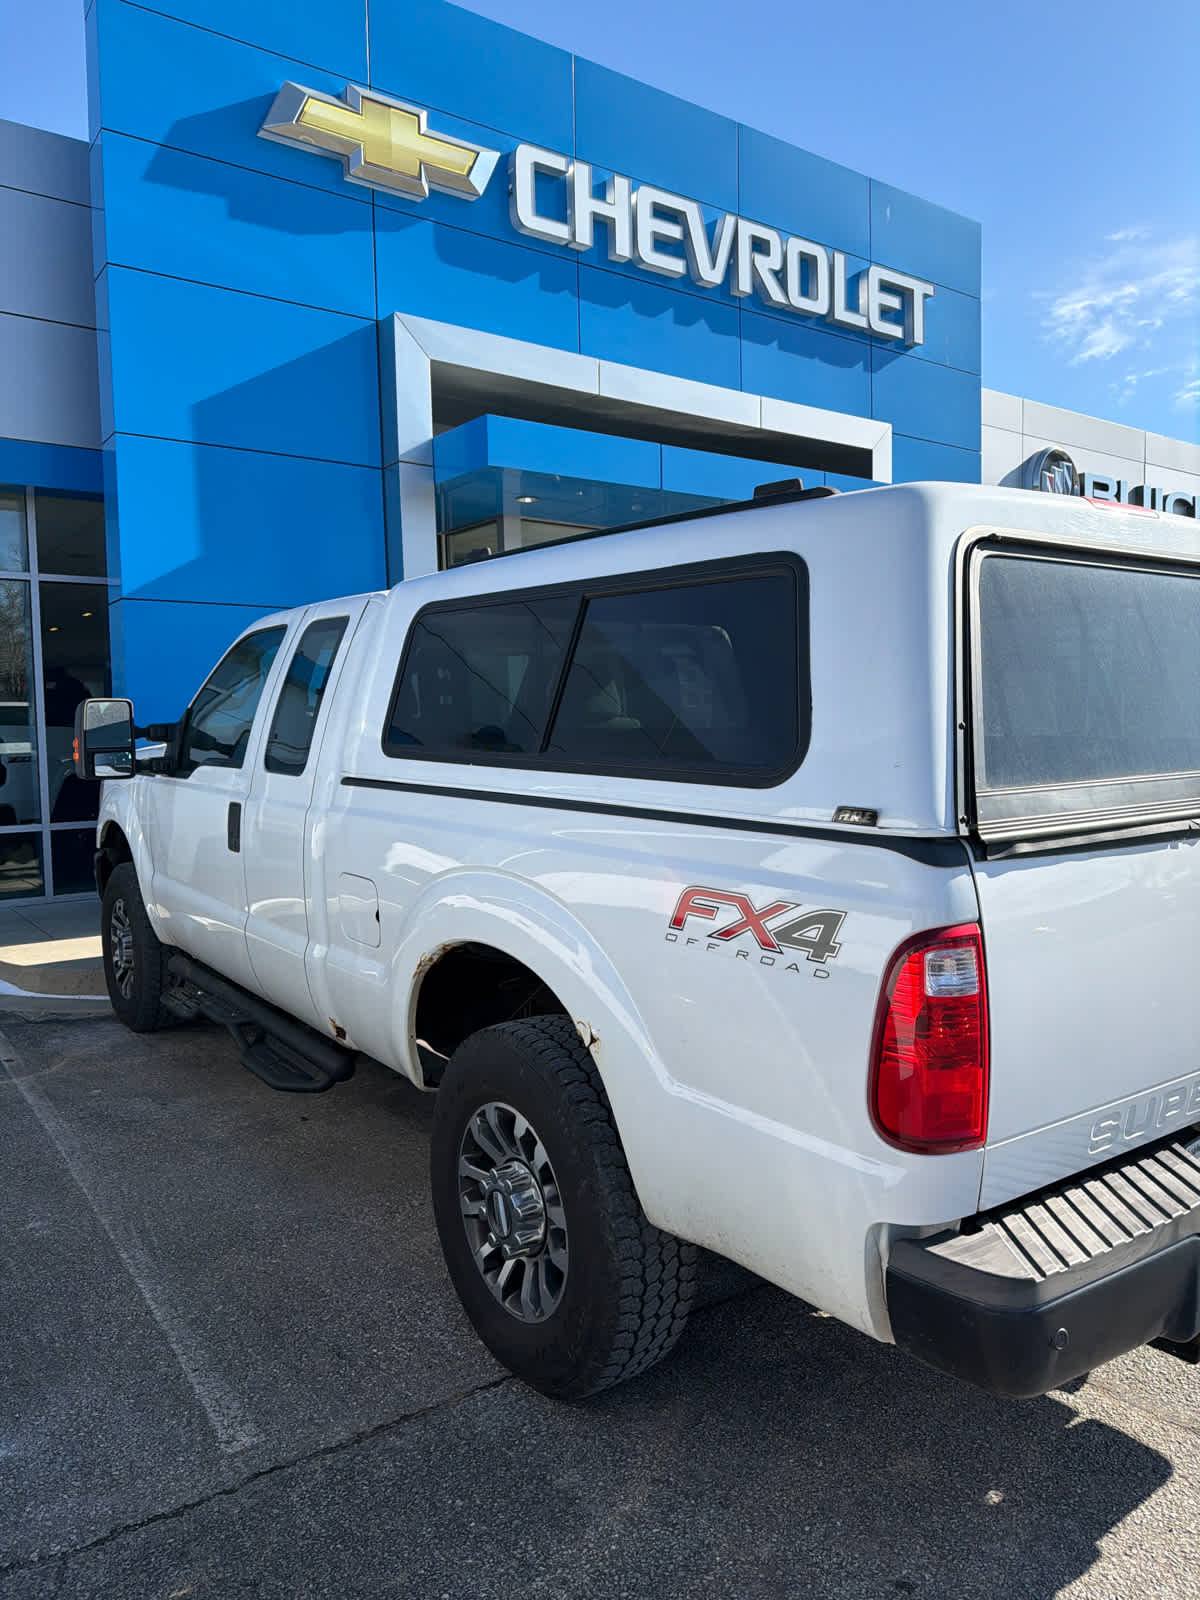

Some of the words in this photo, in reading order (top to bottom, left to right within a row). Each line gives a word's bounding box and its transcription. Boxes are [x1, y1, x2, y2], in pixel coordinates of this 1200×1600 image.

[510, 143, 935, 346] CHEVROLET
[1083, 471, 1200, 519] BUIC
[665, 932, 721, 951] OFF
[735, 949, 830, 980] ROAD
[668, 885, 848, 964] FX4
